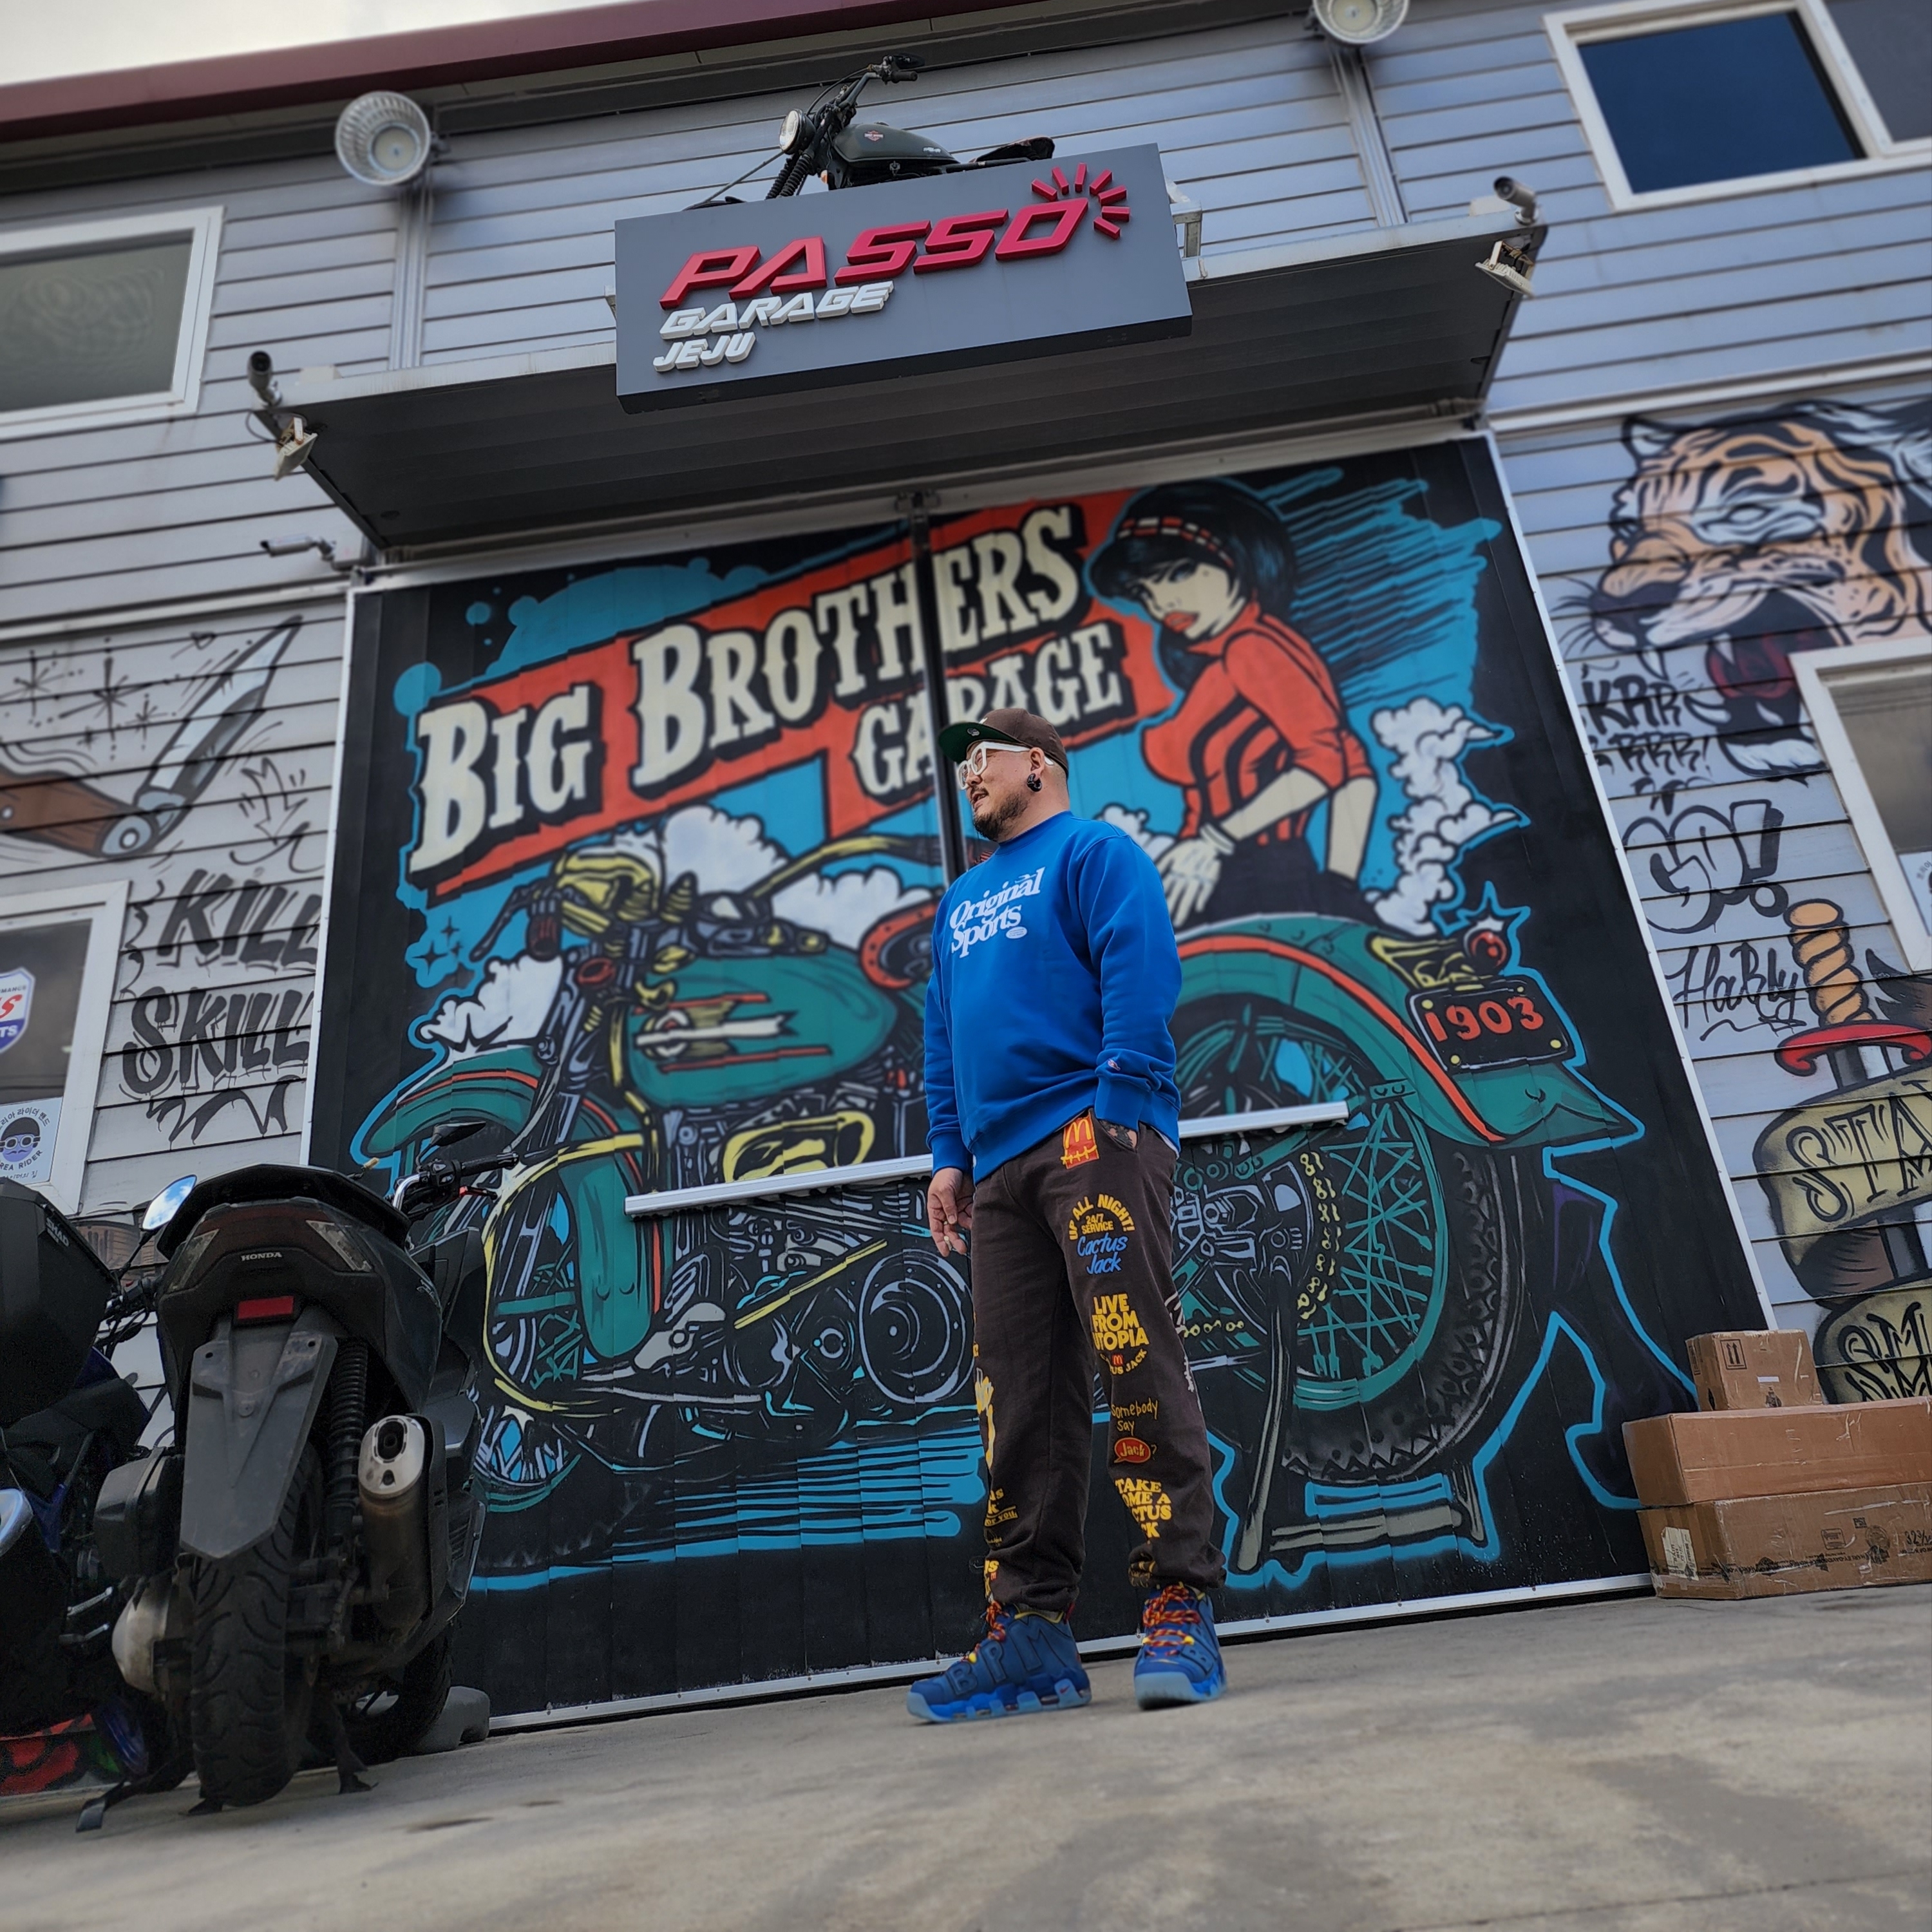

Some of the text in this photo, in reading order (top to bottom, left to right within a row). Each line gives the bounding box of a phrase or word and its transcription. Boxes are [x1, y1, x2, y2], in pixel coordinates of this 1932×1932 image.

[660, 198, 1088, 308] PASSO
[660, 281, 894, 339] GARAGE
[652, 332, 756, 372] JEJU
[410, 506, 1079, 873] BIG BROTHERS
[950, 866, 1046, 929] Original
[158, 869, 321, 965] KILL
[951, 905, 1022, 958] Sports
[0, 985, 27, 994] MANCE
[1425, 996, 1544, 1041] 1903
[122, 986, 314, 1095] SKILL
[18, 1150, 43, 1170] RIDER
[1069, 1193, 1135, 1240] UP ALL NIGHT!
[1081, 1220, 1114, 1235] SERVICE
[1086, 1213, 1104, 1225] 24/7
[1077, 1232, 1128, 1256] Cactus
[241, 1251, 283, 1262] HONDA
[1086, 1251, 1122, 1274] Jack
[1094, 1293, 1130, 1314] LIVE
[1092, 1310, 1140, 1333] FROM
[1092, 1327, 1150, 1351] UTOPIA
[1126, 1349, 1148, 1372] JACK
[1120, 1443, 1146, 1457] Jack
[1115, 1477, 1162, 1493] TAKE
[1122, 1492, 1171, 1508] OME A
[1132, 1504, 1172, 1522] CTUS
